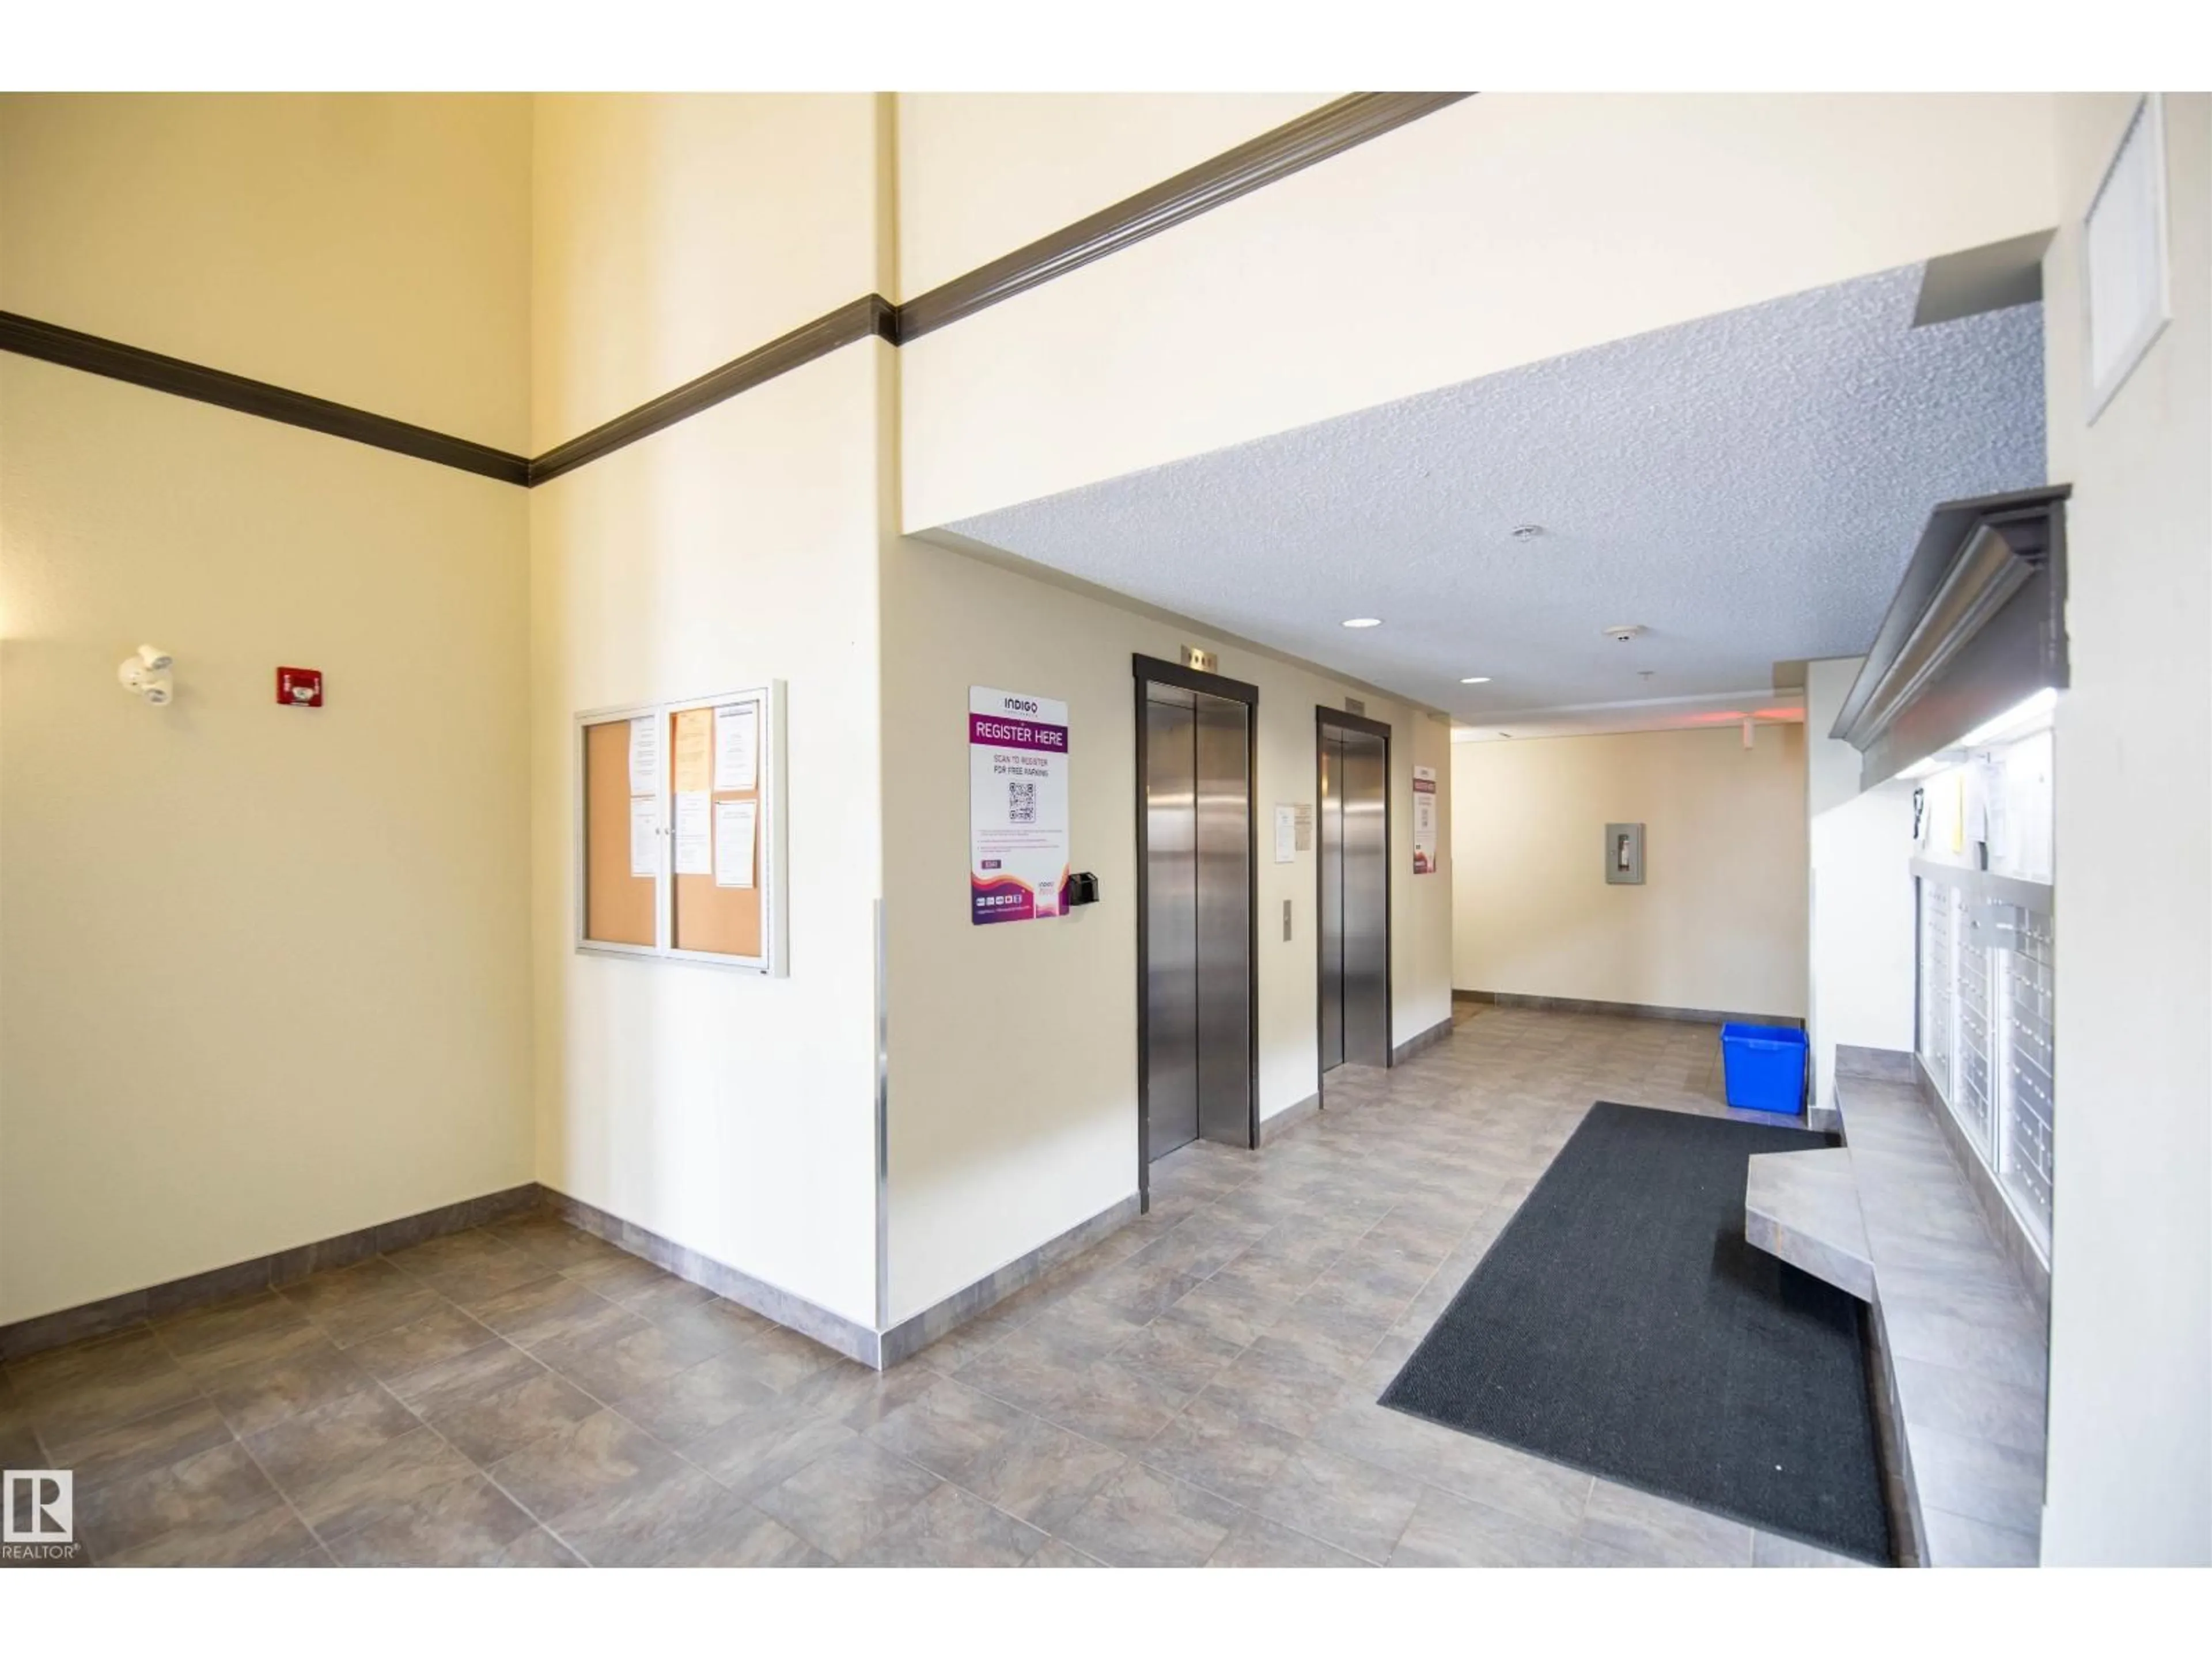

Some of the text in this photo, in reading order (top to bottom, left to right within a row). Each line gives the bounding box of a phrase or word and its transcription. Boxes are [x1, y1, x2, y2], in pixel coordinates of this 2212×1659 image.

[1005, 698, 1037, 713] INDIGO
[976, 722, 1063, 747] REGISTER HERE
[994, 754, 1010, 763] SCAN
[1012, 755, 1019, 764] TO
[994, 764, 1006, 774] FOR
[1007, 766, 1023, 775] FREE
